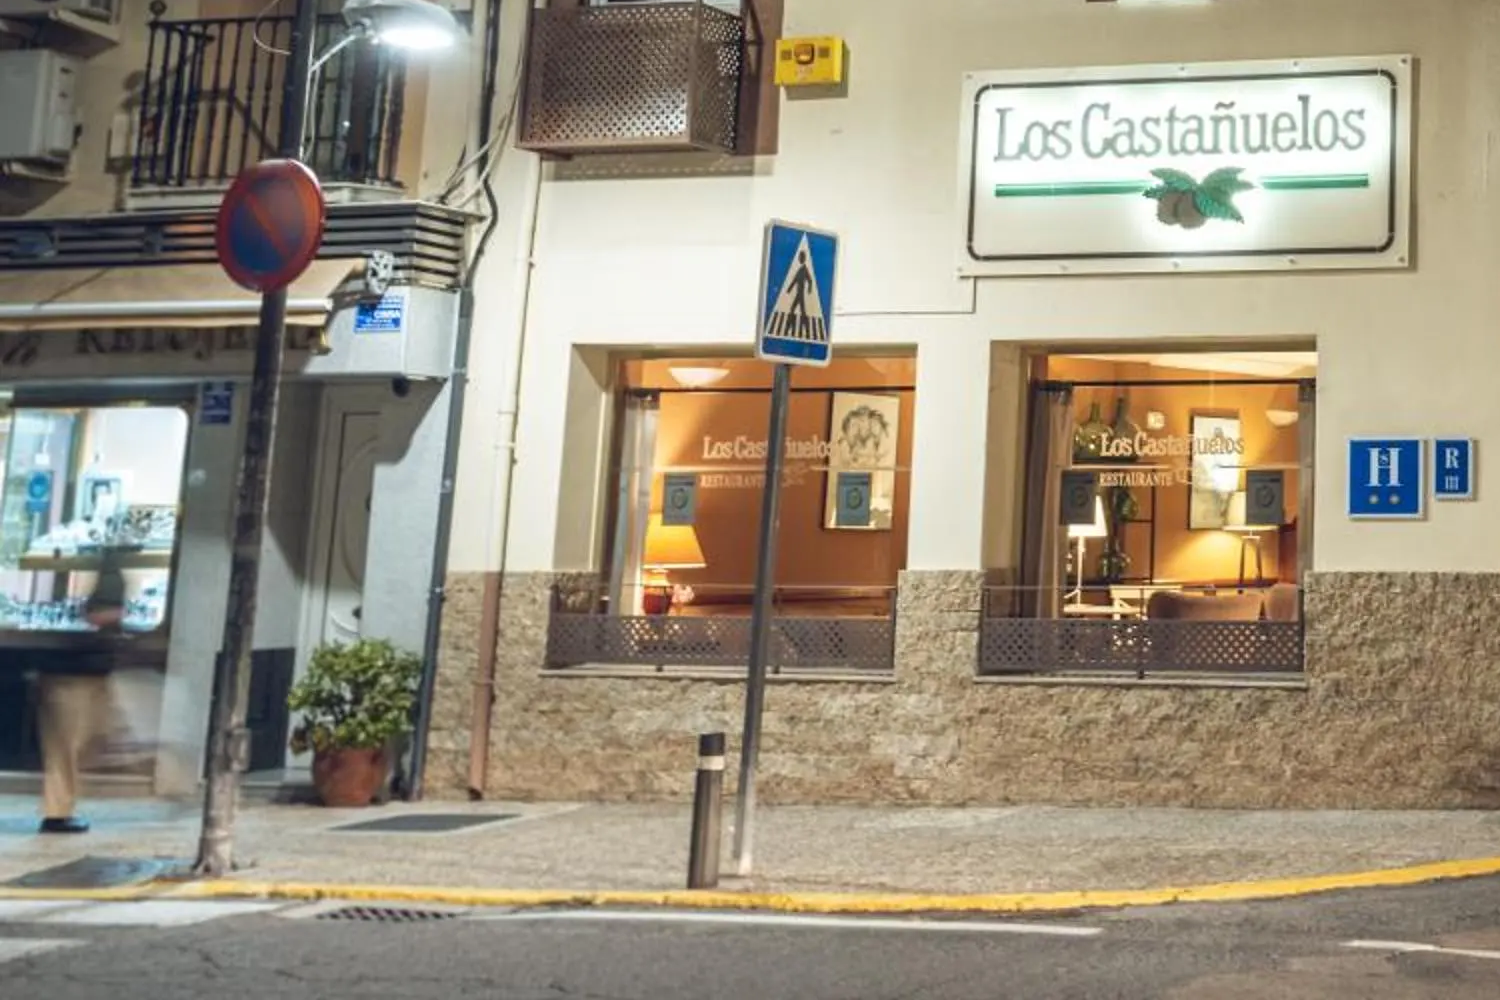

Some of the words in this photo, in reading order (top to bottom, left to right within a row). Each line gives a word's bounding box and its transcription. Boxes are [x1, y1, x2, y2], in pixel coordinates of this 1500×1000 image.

[993, 106, 1073, 162] Los
[1081, 94, 1367, 159] Castañuelos
[702, 435, 733, 459] Los
[1100, 431, 1133, 457] Los
[1364, 447, 1404, 487] H
[1444, 447, 1460, 469] R
